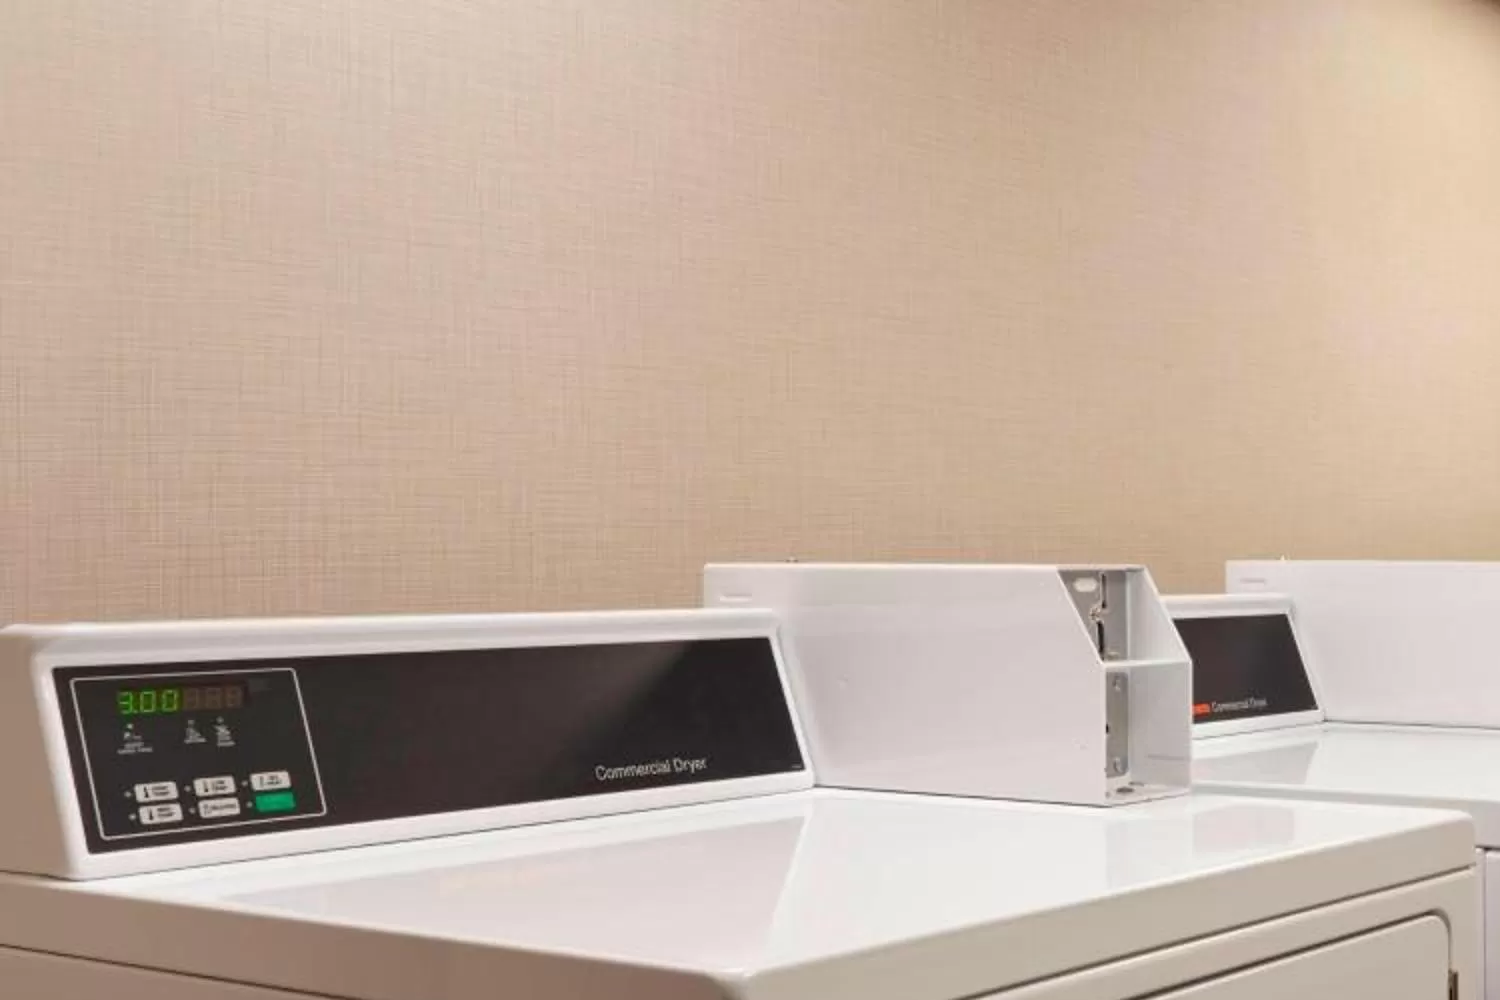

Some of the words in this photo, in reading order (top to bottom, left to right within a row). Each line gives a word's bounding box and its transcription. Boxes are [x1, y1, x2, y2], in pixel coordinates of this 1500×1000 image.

[119, 690, 178, 714] 3.00
[595, 760, 671, 780] Commercial
[673, 758, 707, 773] Dryer
